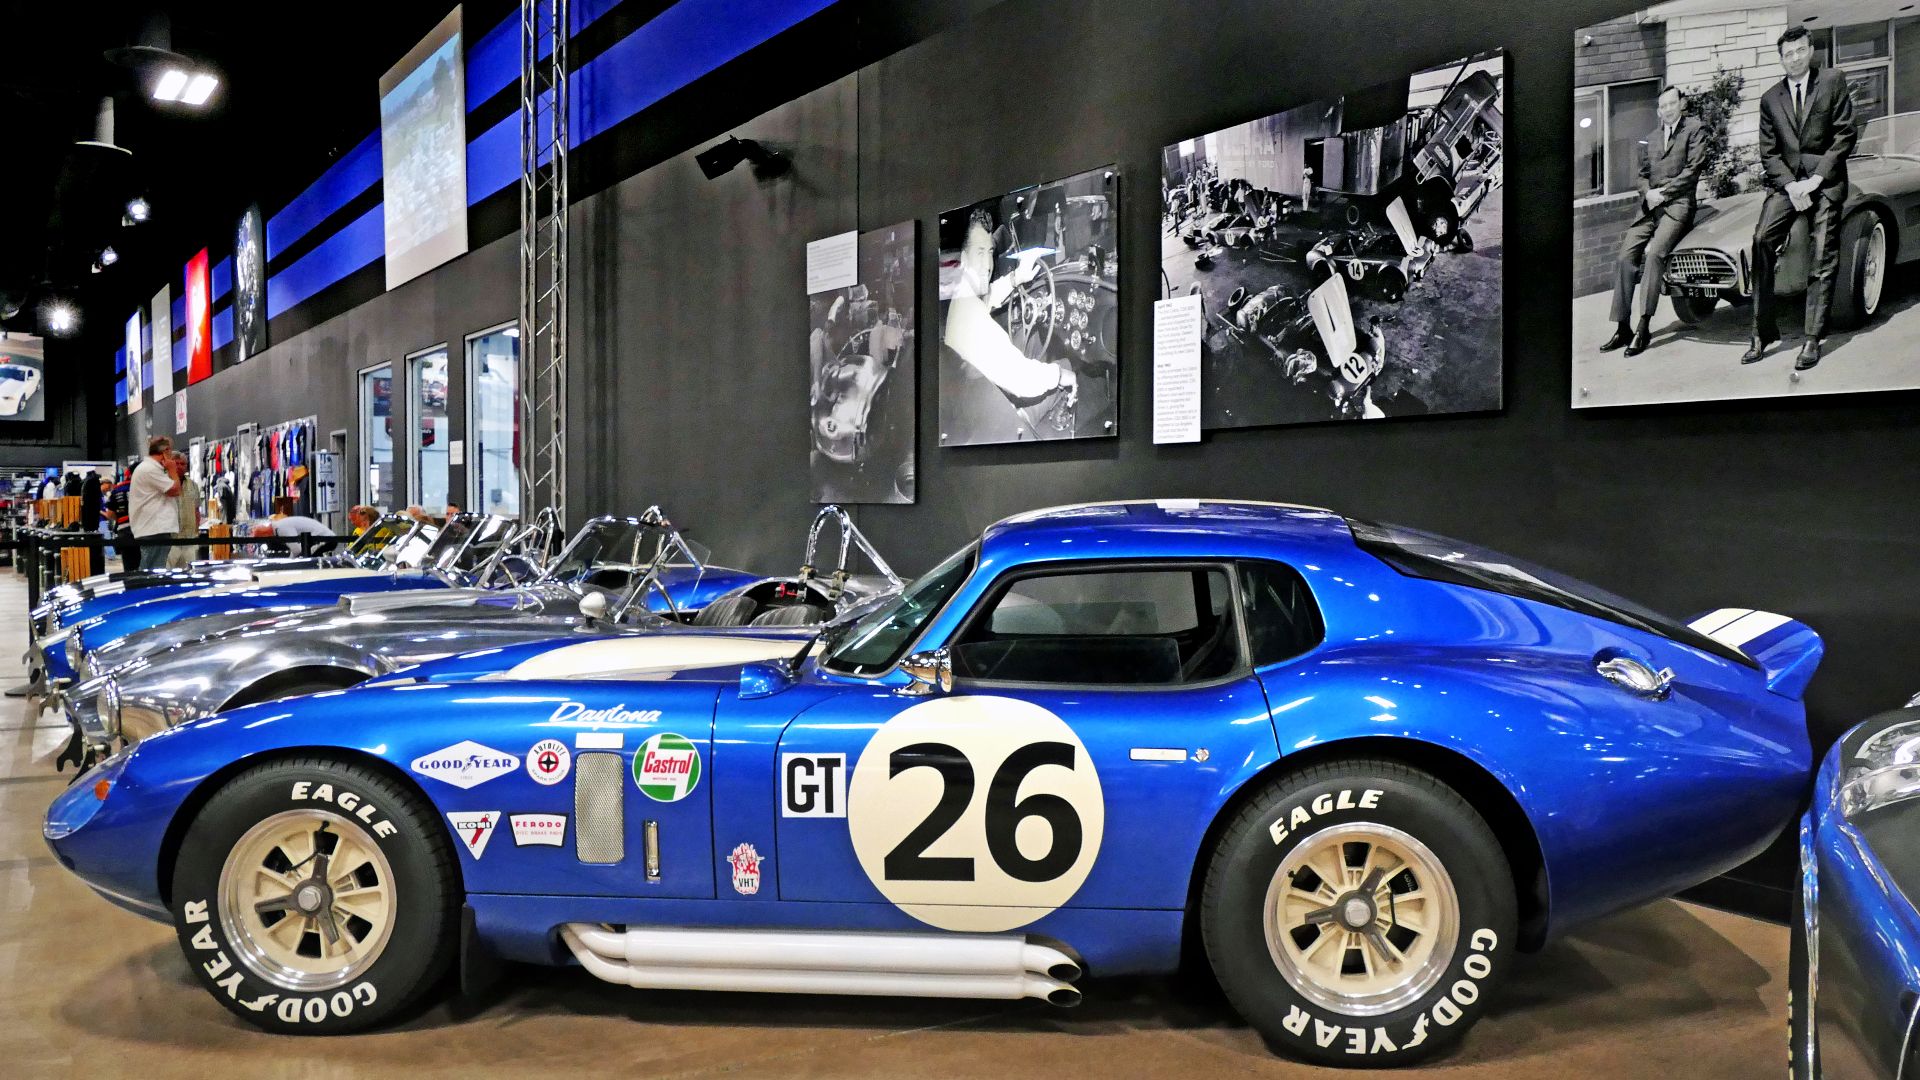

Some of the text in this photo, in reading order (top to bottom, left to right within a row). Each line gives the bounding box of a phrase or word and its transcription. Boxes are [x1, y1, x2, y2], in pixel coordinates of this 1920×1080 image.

[1351, 262, 1361, 277] 14
[1343, 356, 1366, 379] 12
[549, 702, 662, 731] Daytona
[534, 742, 566, 756] AUTOLITE
[644, 751, 693, 774] Castrol
[786, 757, 841, 814] GT
[291, 781, 398, 839] EAGLE
[883, 741, 1083, 883] 26
[1269, 789, 1384, 845] EAGLE
[457, 821, 492, 830] KONI
[738, 878, 754, 887] VHT
